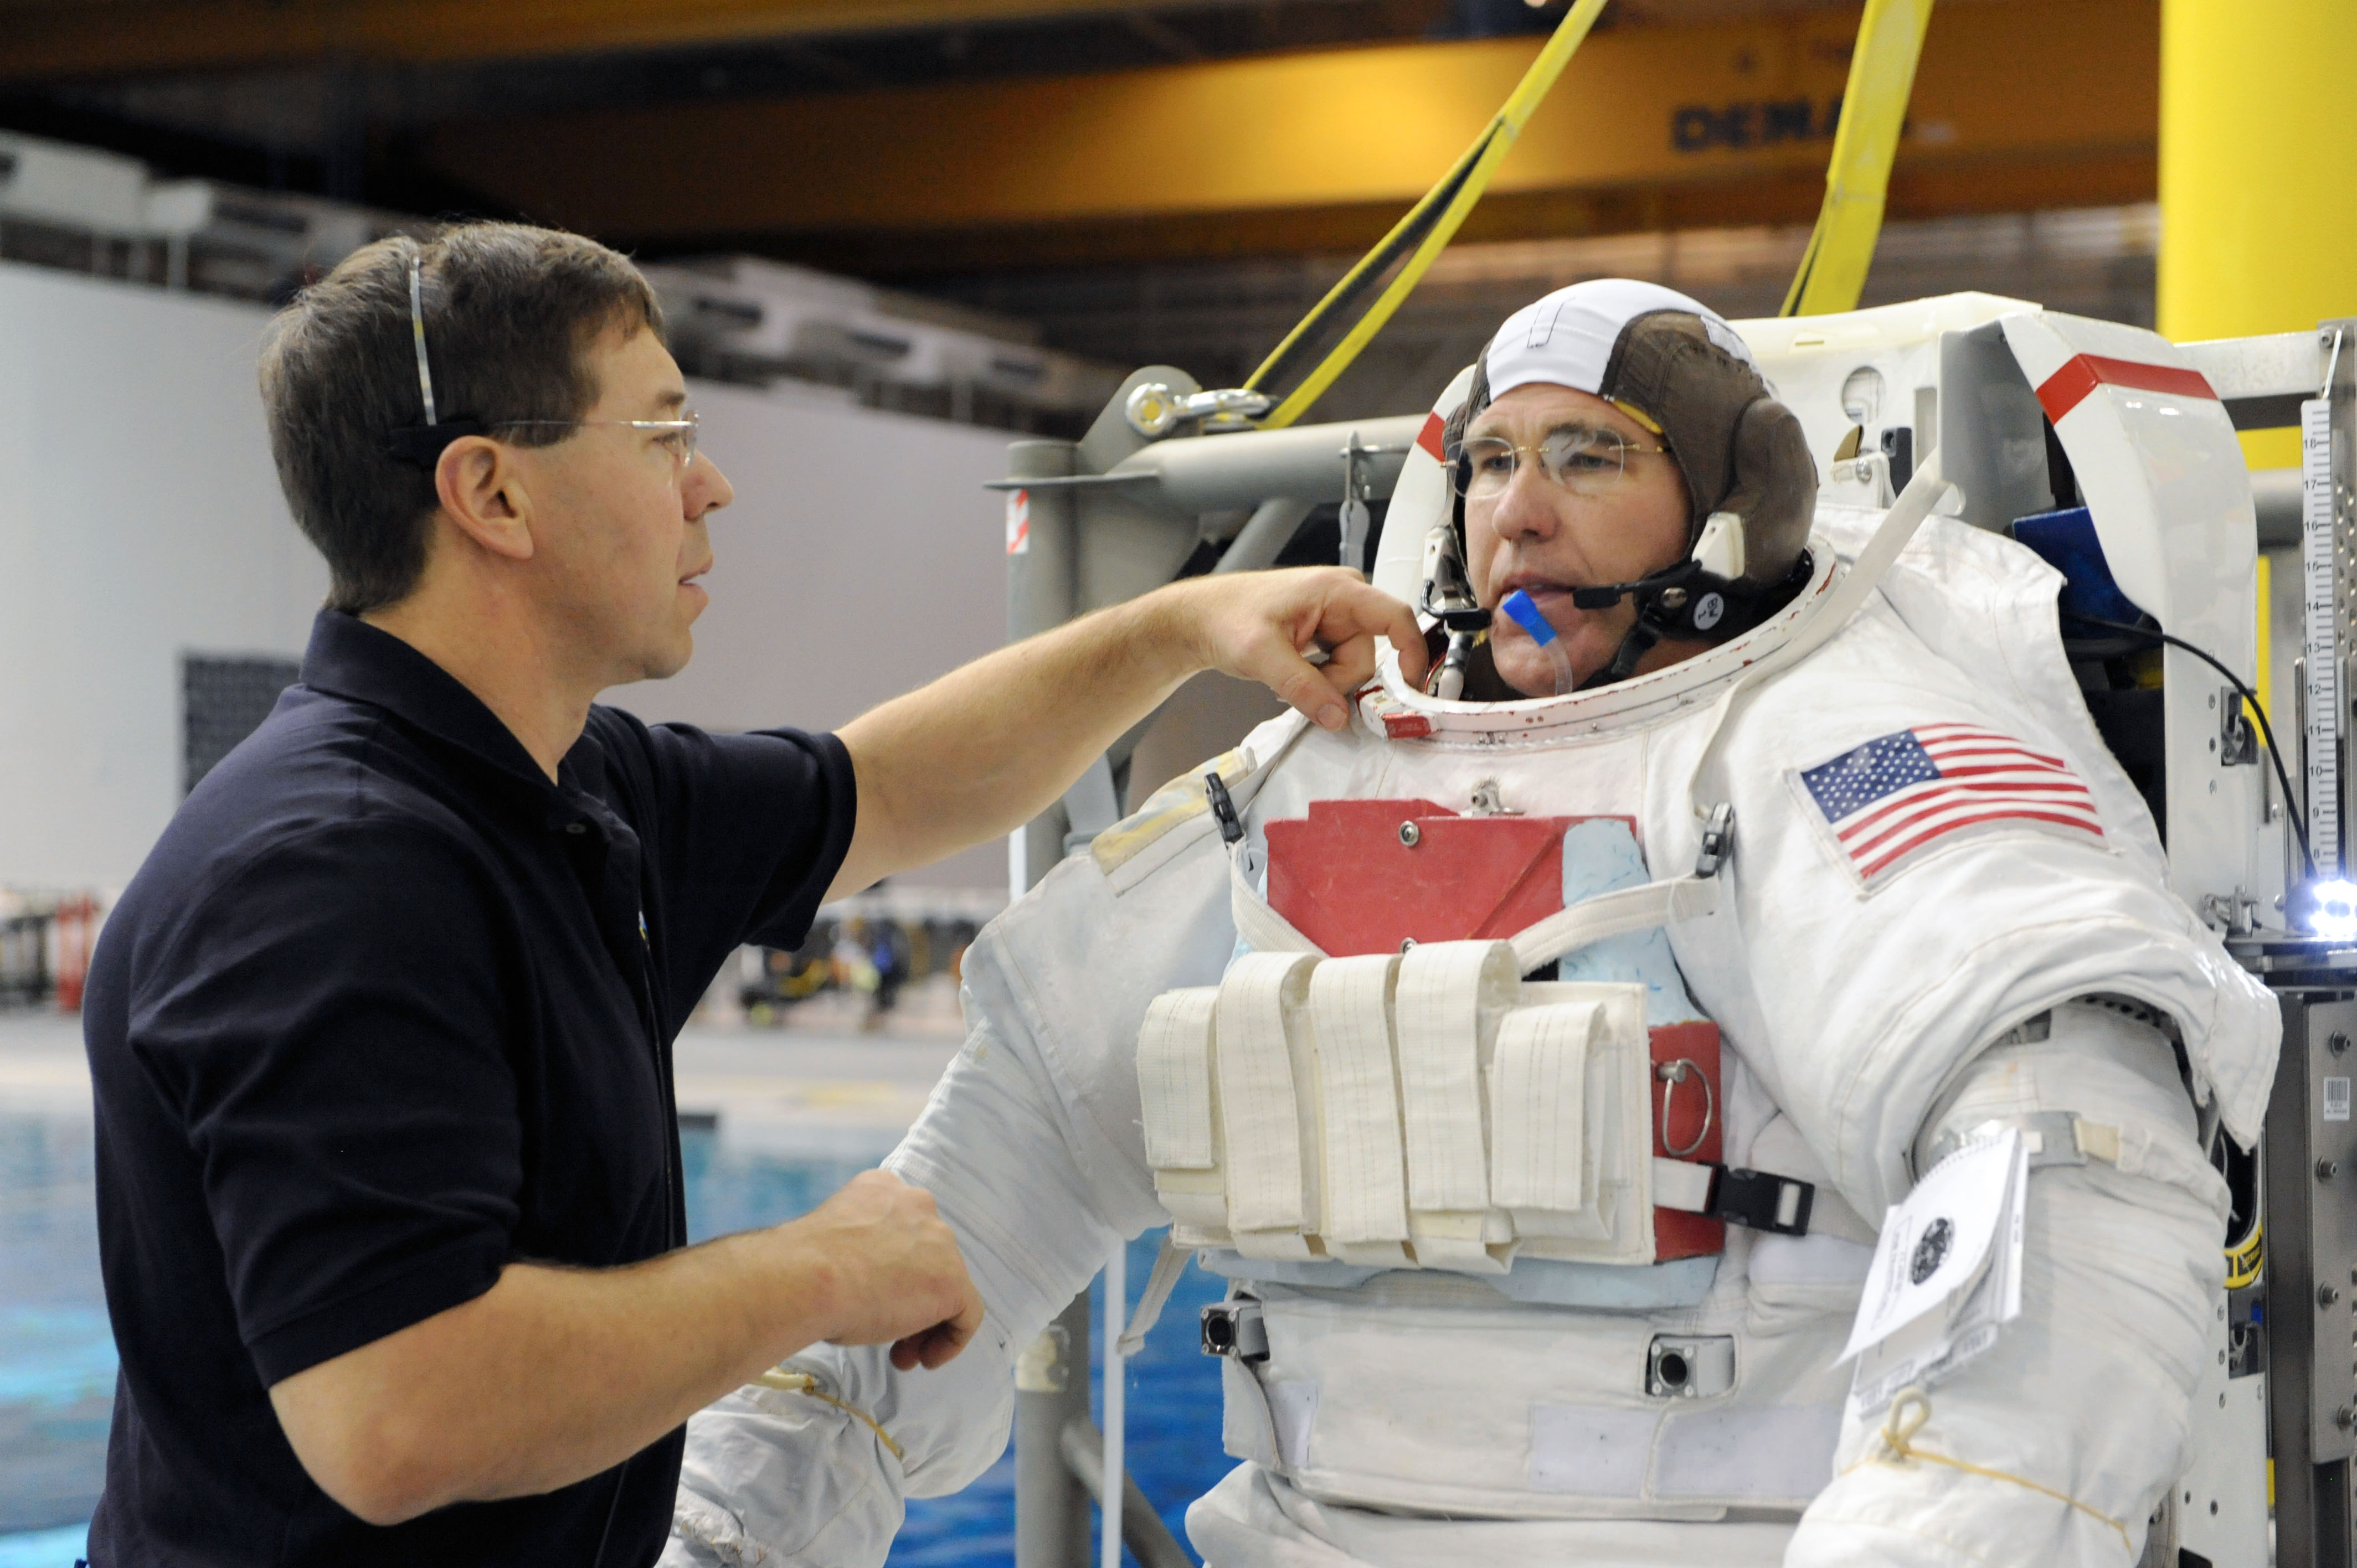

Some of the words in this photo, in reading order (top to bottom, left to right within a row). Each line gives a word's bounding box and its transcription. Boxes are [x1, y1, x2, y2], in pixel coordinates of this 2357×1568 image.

[2304, 439, 2316, 449] 18
[2304, 479, 2317, 490] 17
[2305, 520, 2318, 532] 16
[2306, 561, 2319, 572] 15
[2307, 601, 2319, 612] 14
[2307, 642, 2320, 653] 13
[2308, 684, 2321, 695] 12
[2309, 725, 2320, 735] 11
[2309, 766, 2322, 776] 10
[2313, 807, 2319, 818] 9
